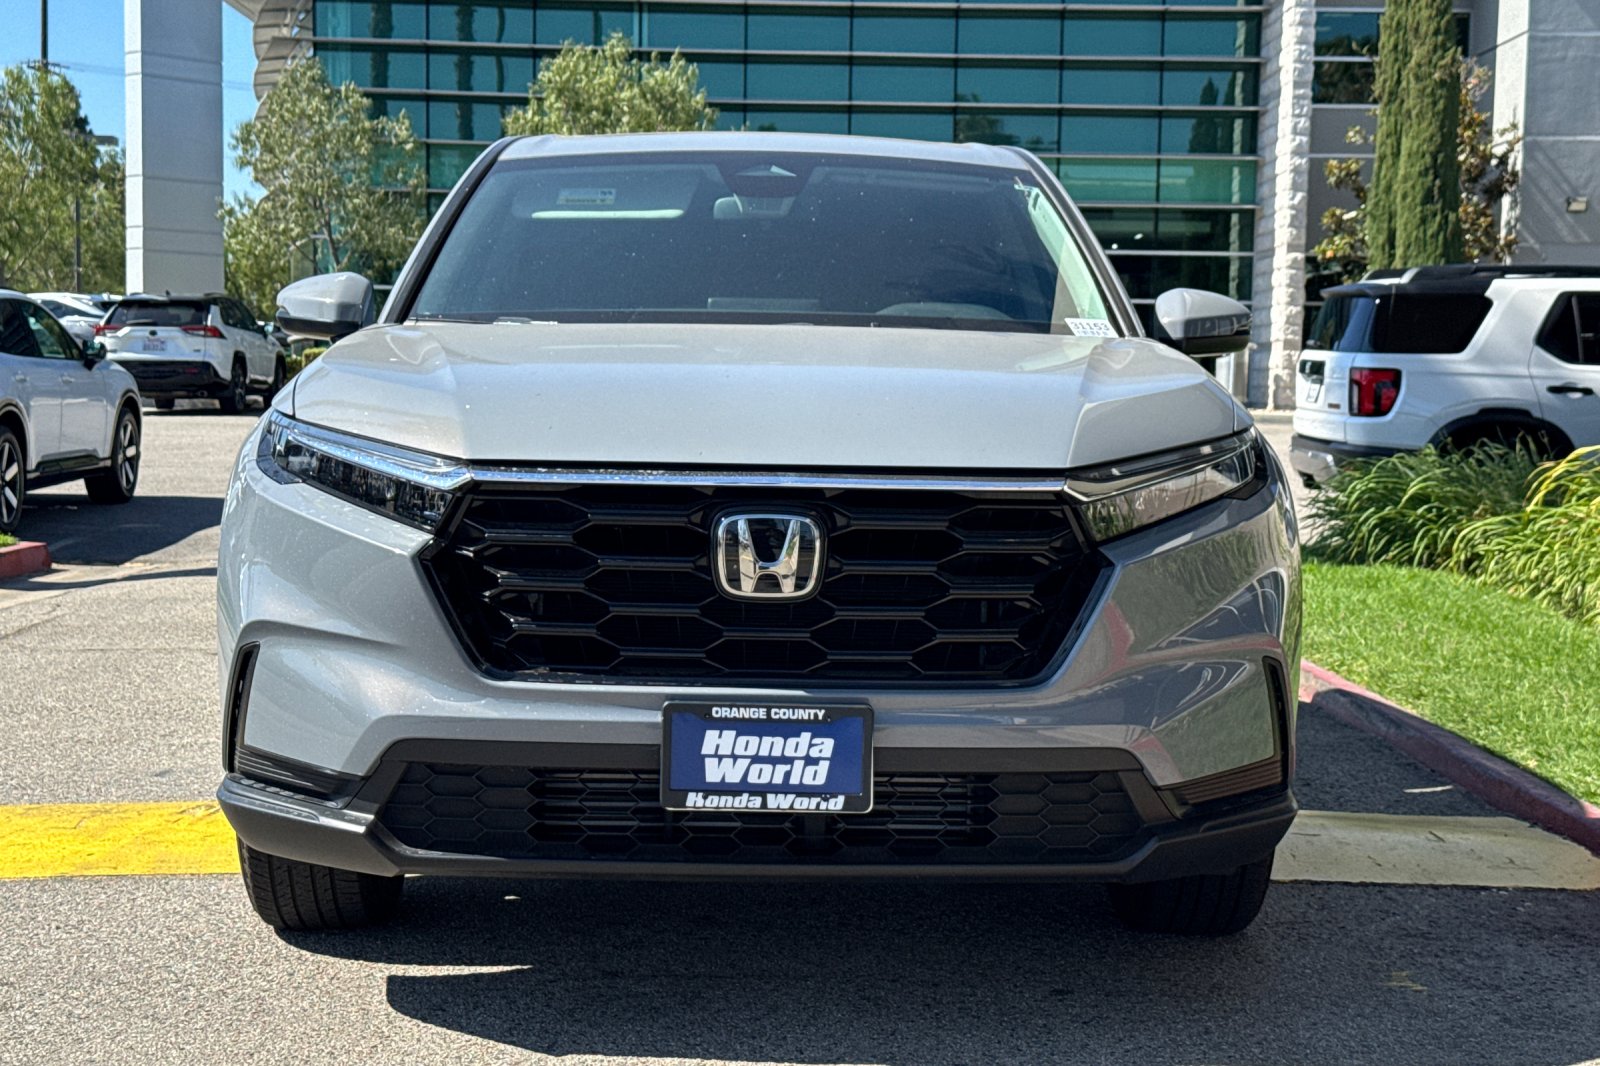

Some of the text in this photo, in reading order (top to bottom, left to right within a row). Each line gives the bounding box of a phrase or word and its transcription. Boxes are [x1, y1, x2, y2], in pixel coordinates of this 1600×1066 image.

[1070, 322, 1110, 330] 31153
[712, 707, 825, 720] ORANGE COUNTY
[701, 730, 835, 758] Honda
[704, 757, 830, 785] World
[685, 792, 763, 809] Honda
